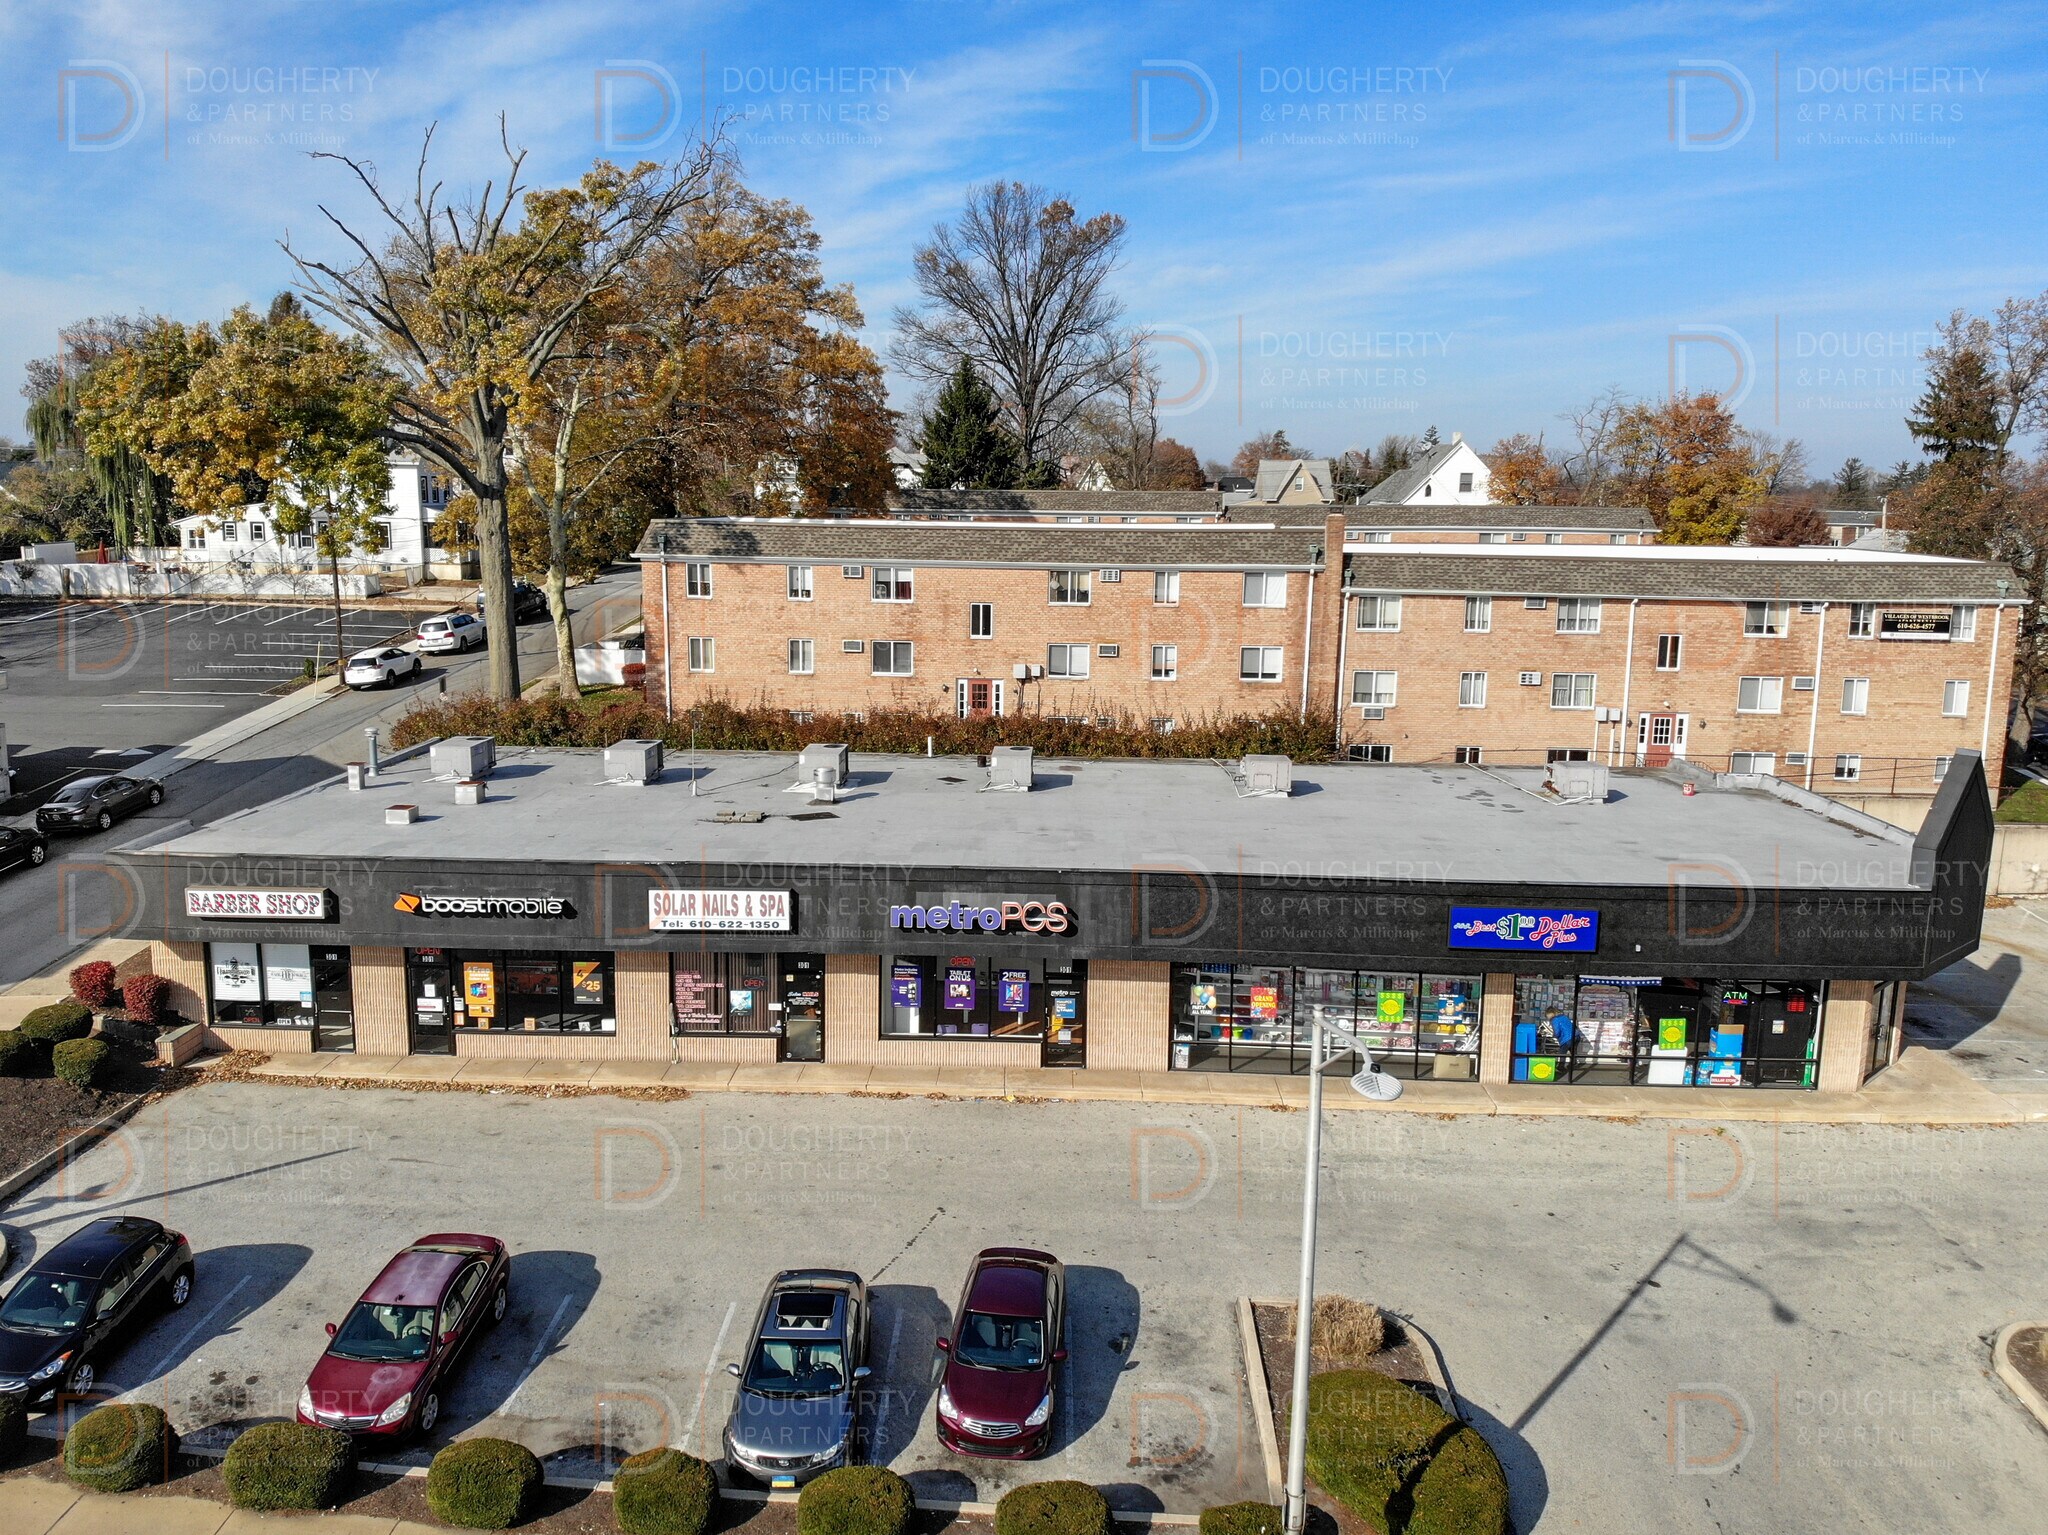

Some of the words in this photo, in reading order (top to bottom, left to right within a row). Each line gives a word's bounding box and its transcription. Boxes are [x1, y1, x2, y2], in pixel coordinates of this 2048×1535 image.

[189, 893, 262, 914] BARBER
[266, 894, 320, 915] SHOP
[421, 897, 564, 914] boostmobile
[654, 893, 696, 916] SOLAR
[702, 894, 739, 917] NAILS
[745, 894, 753, 917] &
[760, 894, 786, 917] SPA
[661, 920, 684, 928] Tel:
[689, 920, 780, 929] 610-622-1350
[890, 900, 1068, 932] metroPCS
[1466, 921, 1496, 936] Best
[1529, 914, 1590, 941] Dollar
[1542, 931, 1576, 948] Plus
[950, 956, 975, 966] OPEN
[581, 980, 601, 991] $25
[744, 979, 765, 988] OPEN
[1002, 972, 1009, 982] 2
